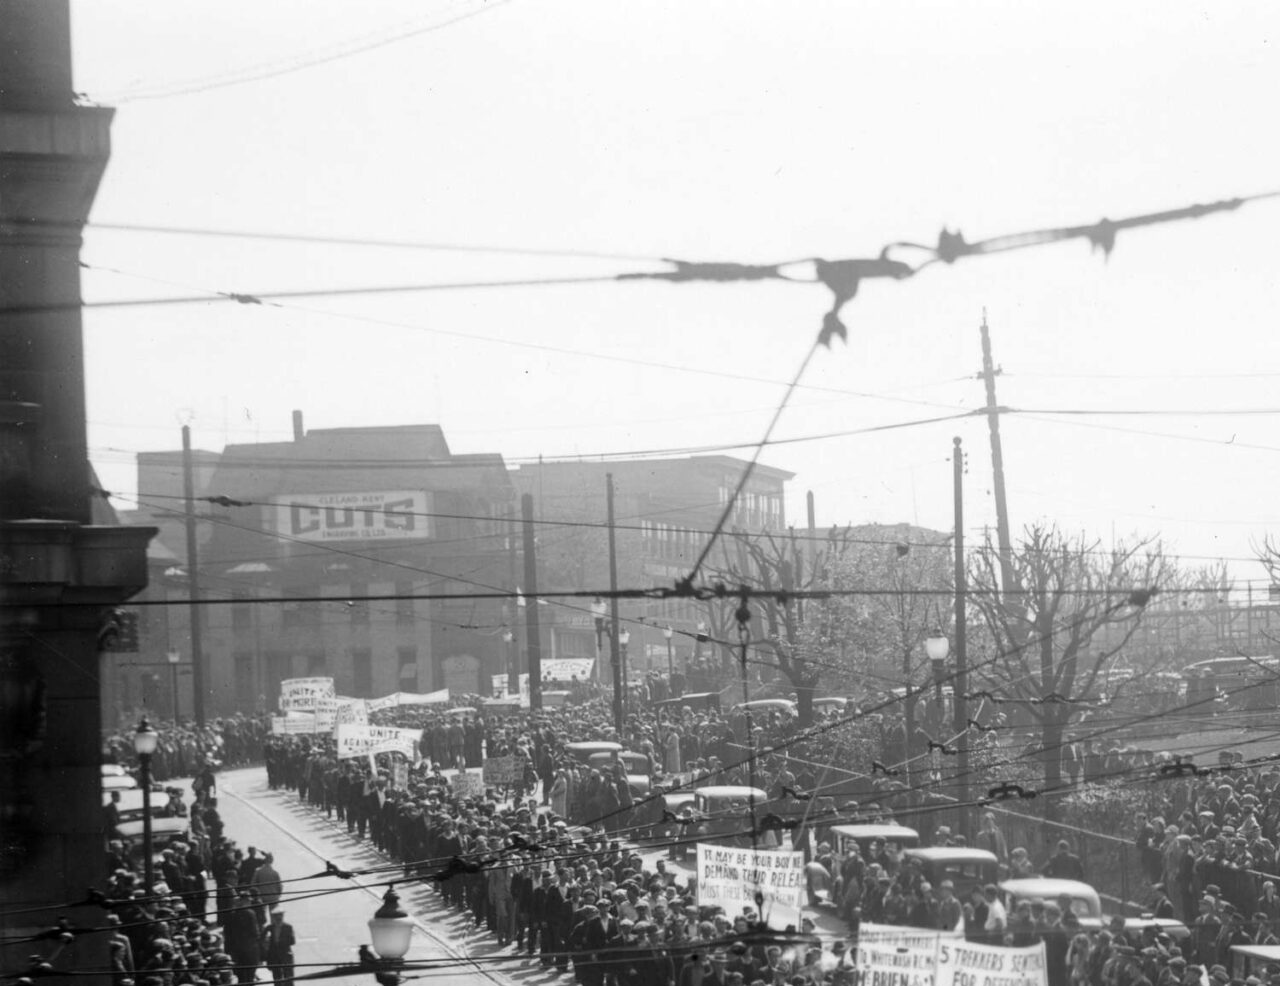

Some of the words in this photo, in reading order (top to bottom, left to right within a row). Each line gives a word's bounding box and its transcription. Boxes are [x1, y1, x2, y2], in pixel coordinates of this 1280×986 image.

[290, 498, 415, 535] CUTS
[369, 728, 400, 740] UNITE
[704, 849, 712, 861] IT
[715, 850, 734, 864] MAY
[736, 853, 747, 866] BE
[751, 854, 772, 868] YOUR
[775, 855, 791, 869] BOY
[704, 864, 739, 881] DEMAND
[939, 945, 950, 964] 5
[954, 947, 1005, 972] TREKKERS
